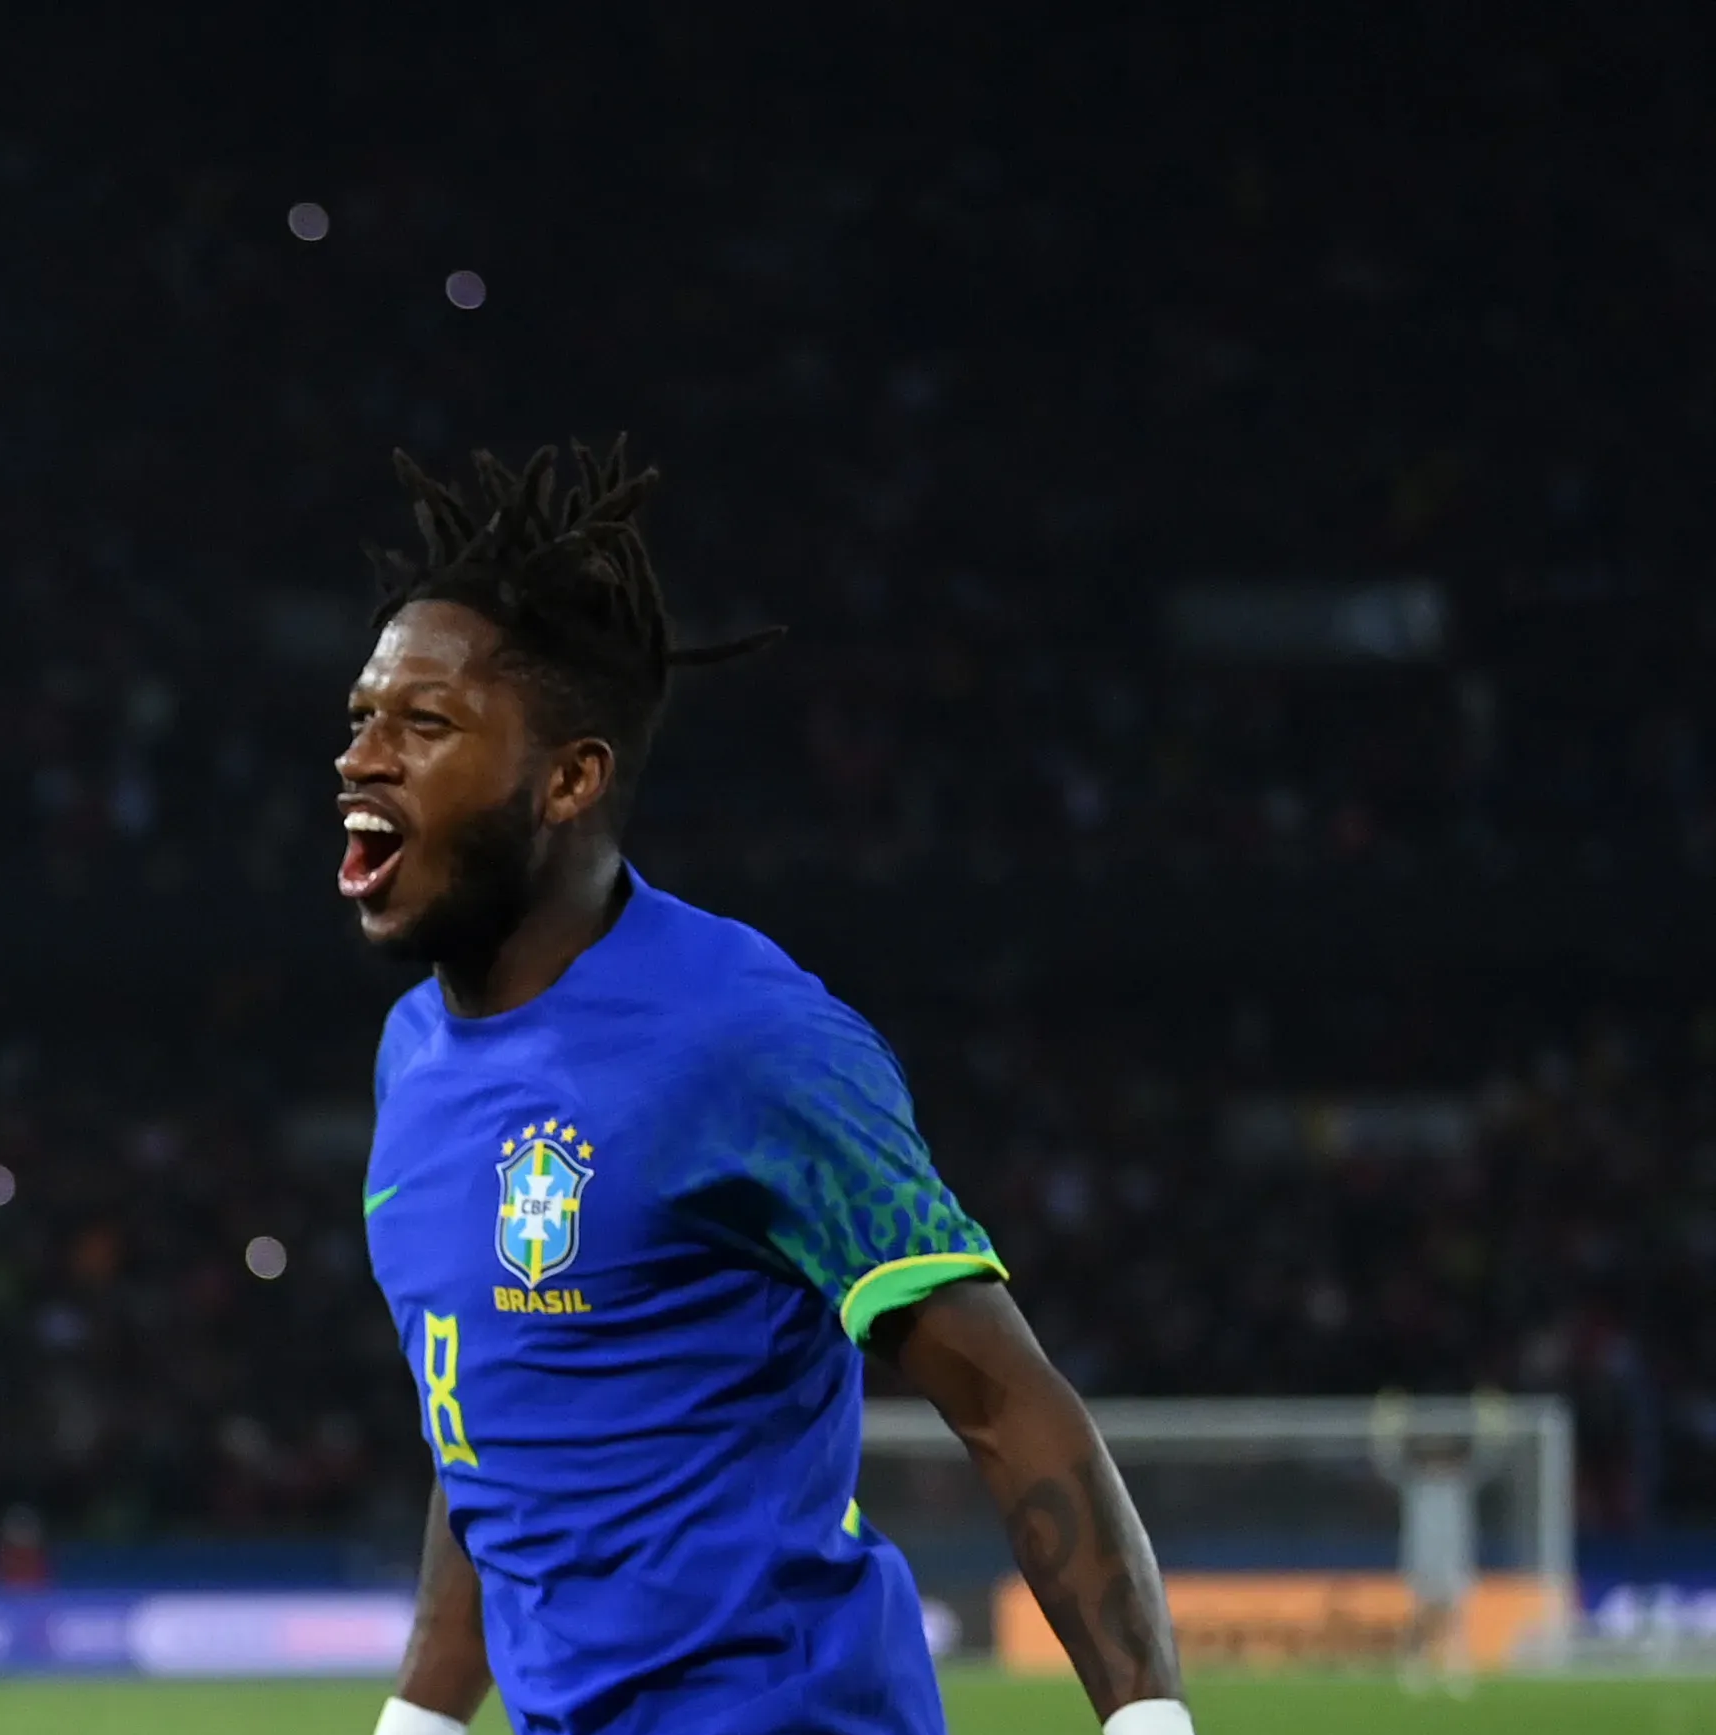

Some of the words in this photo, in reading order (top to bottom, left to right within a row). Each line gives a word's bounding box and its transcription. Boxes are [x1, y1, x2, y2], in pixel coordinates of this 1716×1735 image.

[522, 1199, 553, 1216] CBF
[493, 1285, 591, 1314] BRASIL
[424, 1310, 478, 1468] 8
